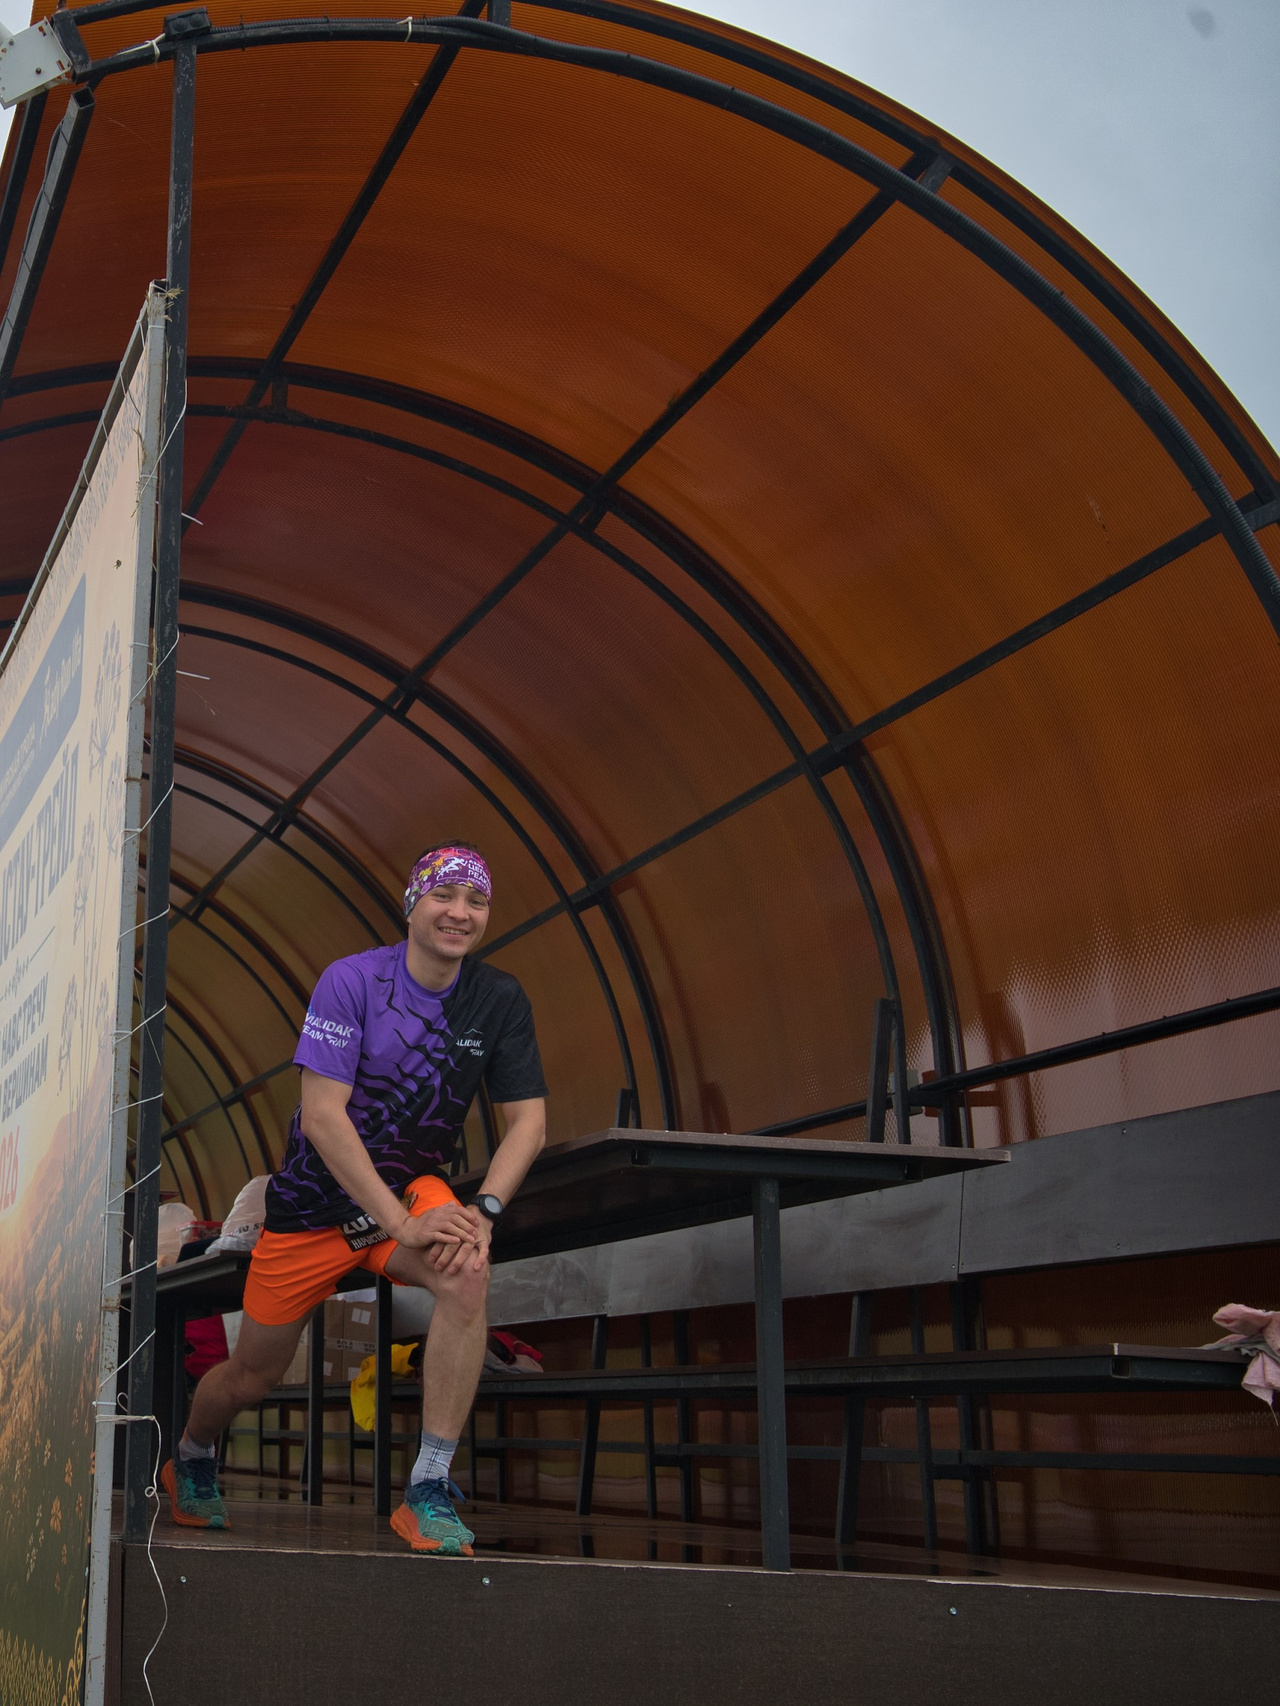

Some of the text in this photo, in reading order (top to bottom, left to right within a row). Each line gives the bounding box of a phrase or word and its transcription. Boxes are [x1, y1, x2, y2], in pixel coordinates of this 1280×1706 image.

[0, 972, 48, 1068] НАВСТРЕЧУ
[303, 1025, 348, 1048] EAM RAY
[456, 1039, 482, 1047] ALIDAK
[1, 1032, 49, 1123] ВЕРШИНАМ
